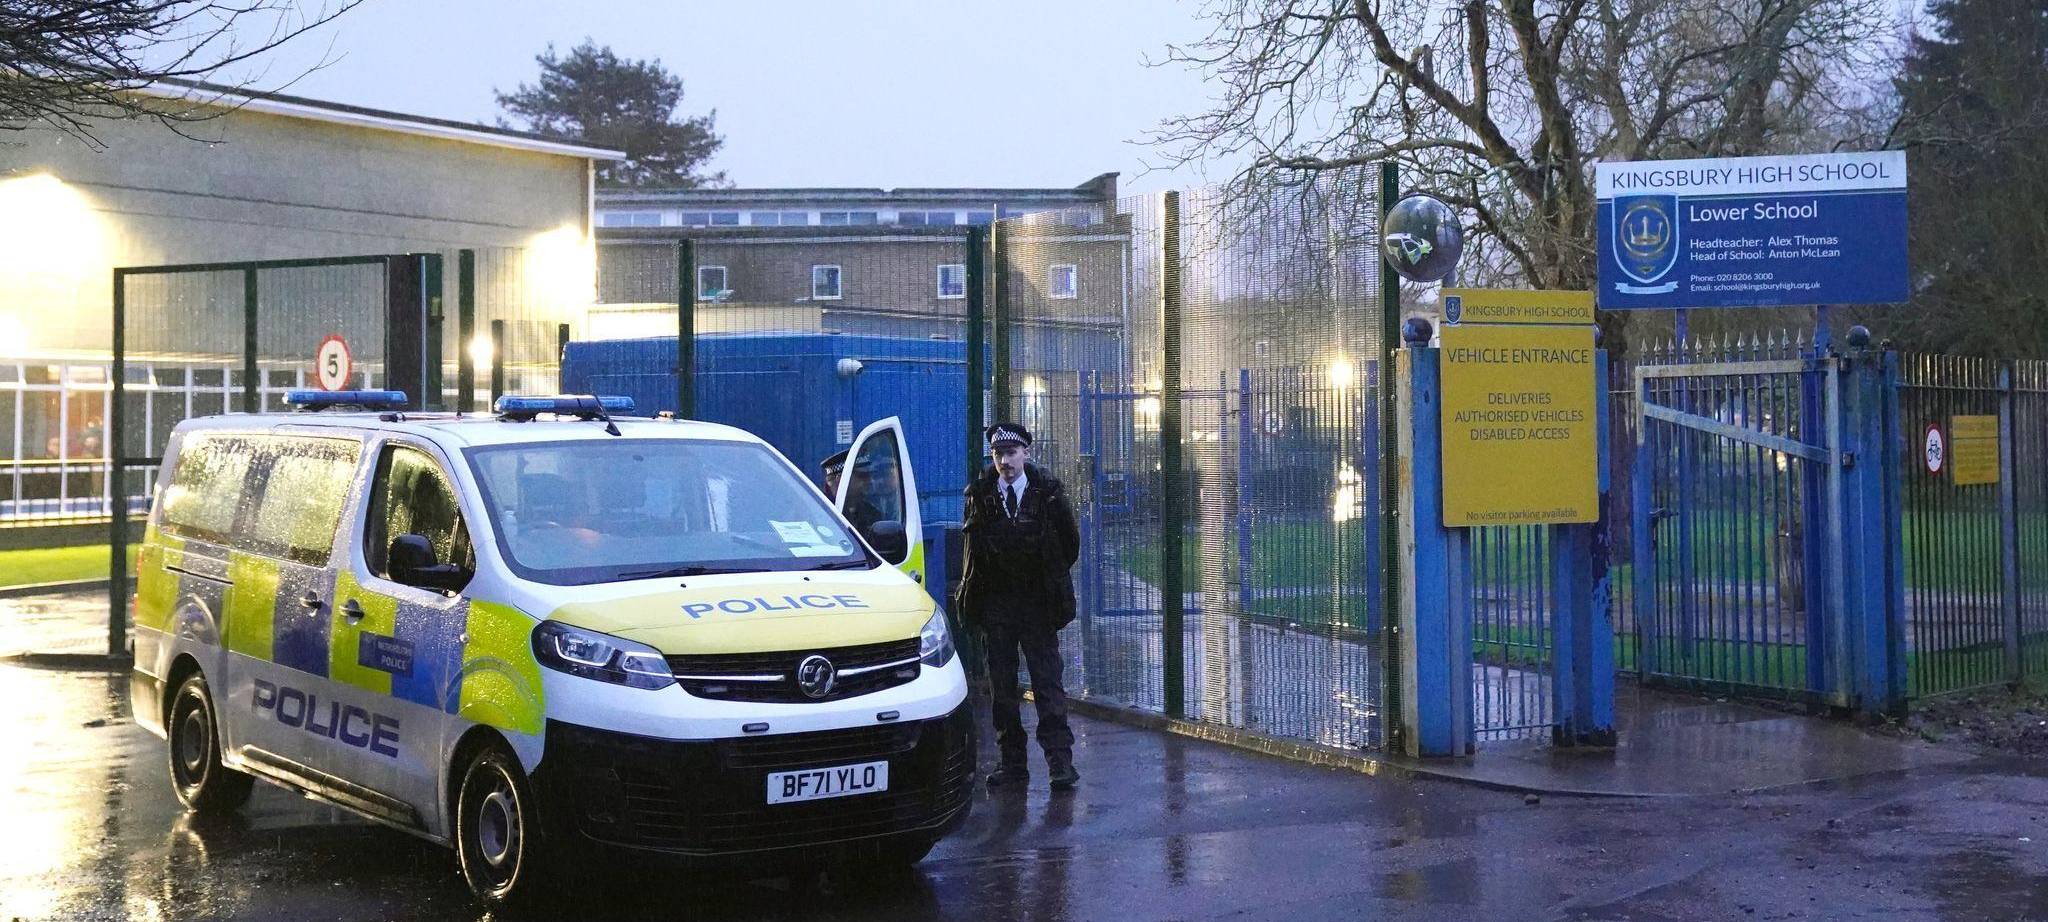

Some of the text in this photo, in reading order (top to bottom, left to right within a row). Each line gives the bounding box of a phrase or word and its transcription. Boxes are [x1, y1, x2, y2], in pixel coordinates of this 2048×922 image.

[1612, 162, 1890, 189] KINGSBURY HIGH SCHOOL
[1690, 200, 1818, 222] Lower School
[1690, 235, 1839, 249] Headteacher: Alex Thomas
[1690, 248, 1841, 261] Head of School: Anton McLean
[1690, 272, 1774, 282] Phone: 020 8206 3000
[1690, 283, 1712, 292] Email:
[1465, 306, 1590, 318] KINGSBURY HIGH SCHOOL
[1447, 348, 1589, 363] VEHICLE ENTRANCE
[328, 353, 338, 378] 5
[1488, 392, 1551, 405] DELIVERIES
[1454, 410, 1584, 422] AUTHORISED VEHICLES
[1470, 427, 1570, 440] DISABLED ACCESS
[1466, 506, 1578, 521] No visitor parking available
[681, 594, 870, 619] POLICE
[381, 654, 407, 670] POLICE
[252, 678, 400, 758] POLICE
[782, 766, 876, 798] BF71 YLO
